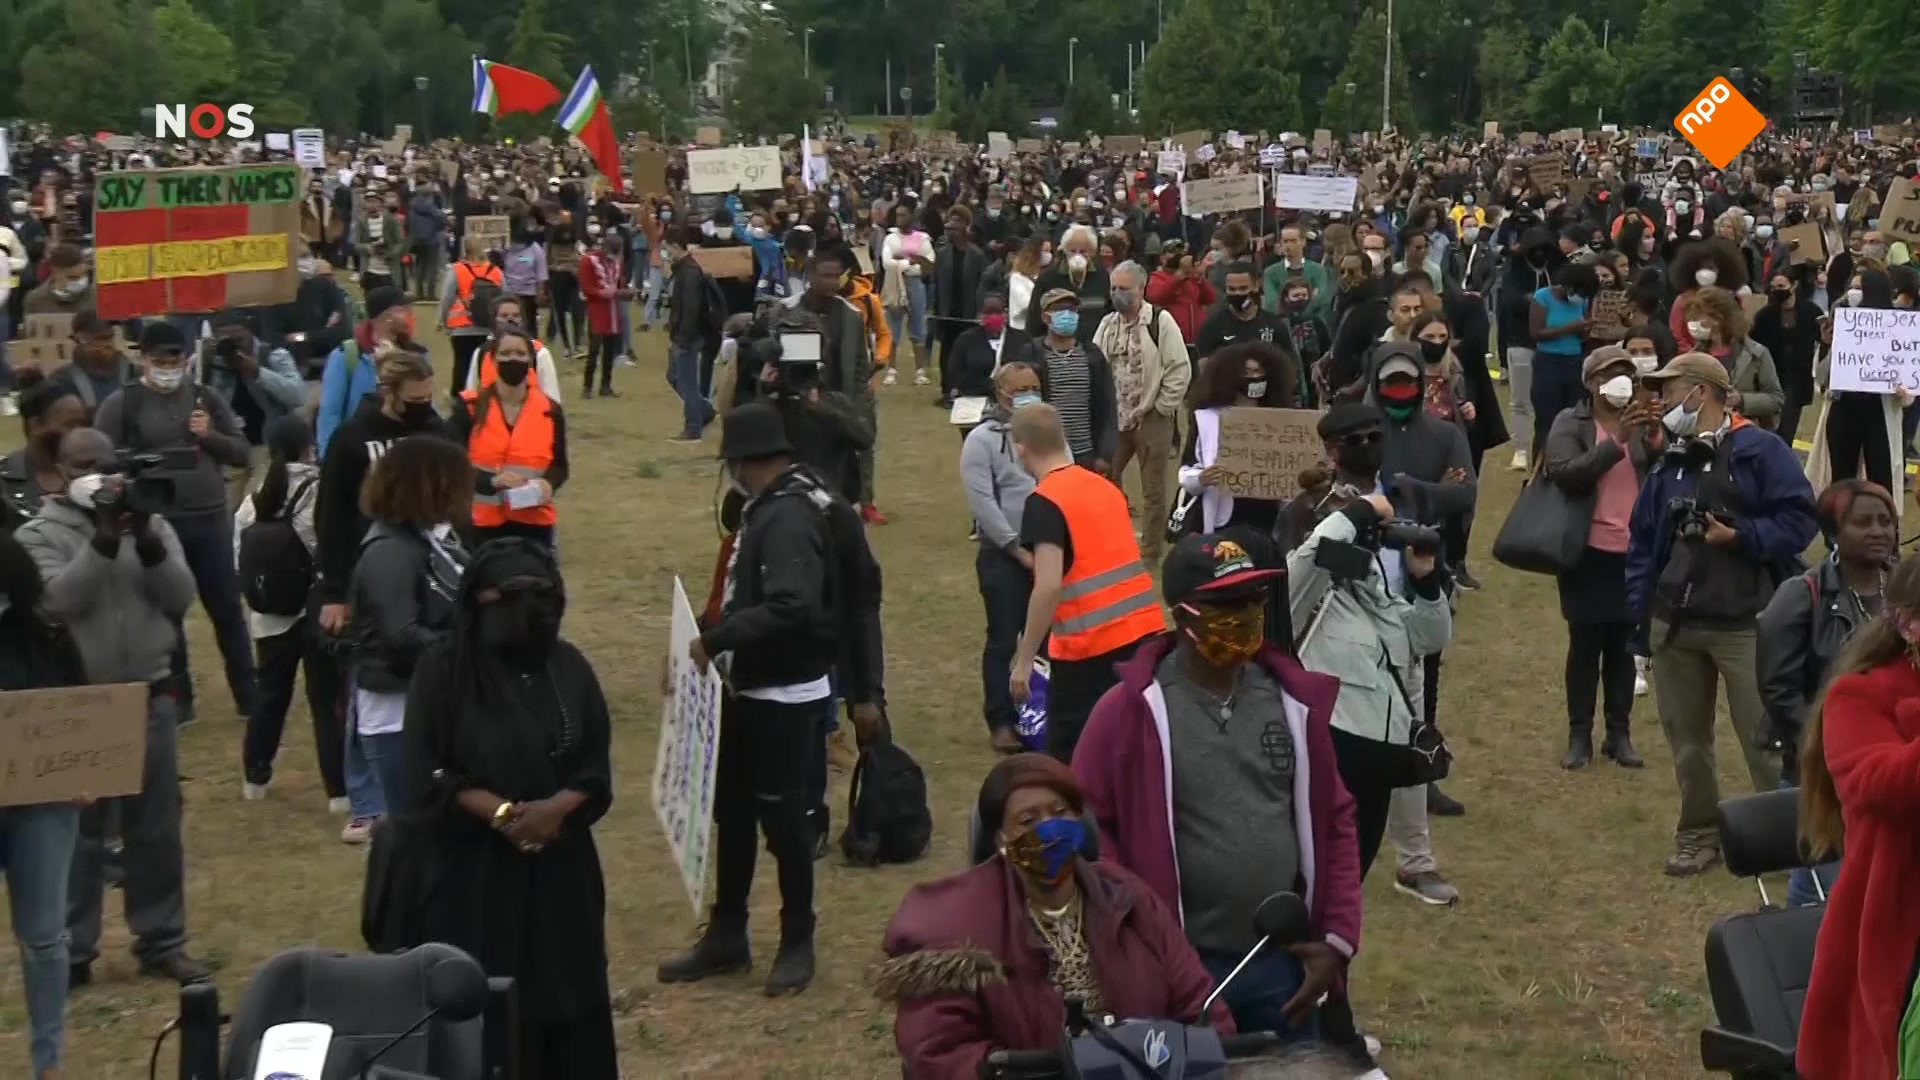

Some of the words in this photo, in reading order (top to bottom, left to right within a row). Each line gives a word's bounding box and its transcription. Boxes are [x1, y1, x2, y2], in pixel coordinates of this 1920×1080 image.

[100, 176, 146, 210] SAY
[156, 173, 222, 205] THEIR
[228, 170, 296, 204] NAMES
